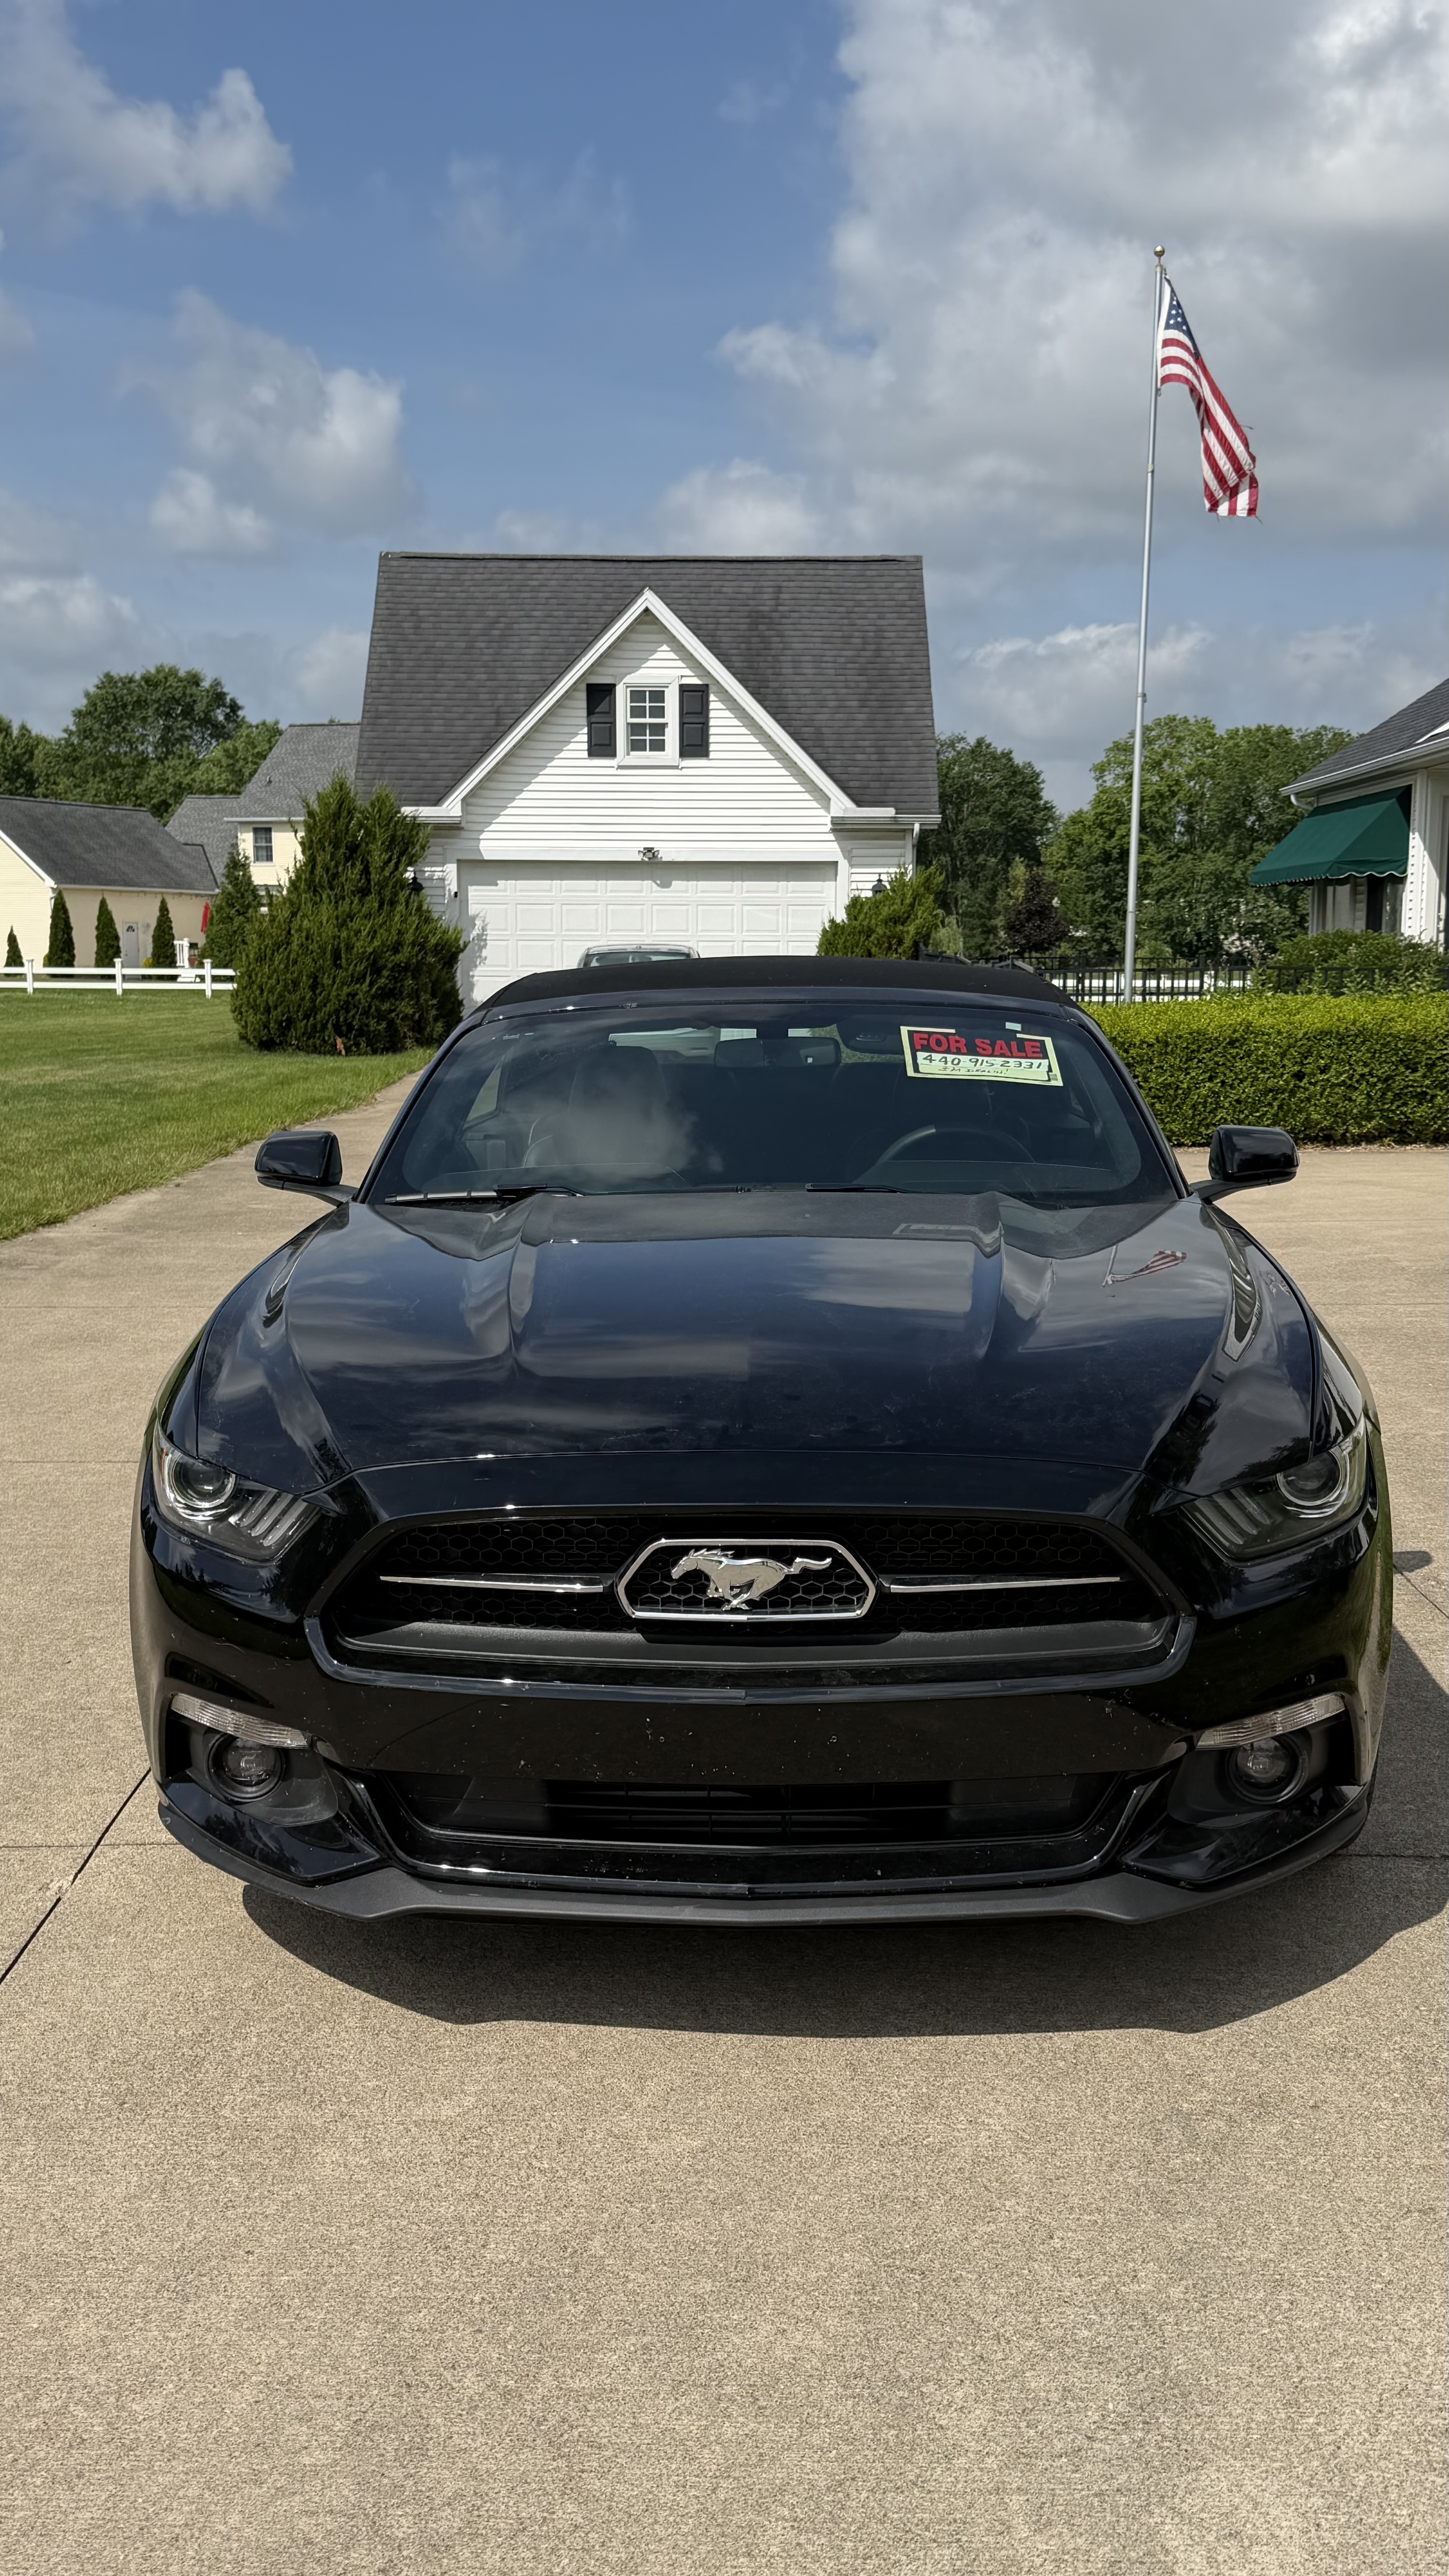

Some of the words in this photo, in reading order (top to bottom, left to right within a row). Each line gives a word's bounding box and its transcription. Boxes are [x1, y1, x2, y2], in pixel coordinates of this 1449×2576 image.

[913, 1033, 967, 1053] FOR
[975, 1039, 1042, 1057] SALE
[922, 1054, 1042, 1069] 440-915-2331
